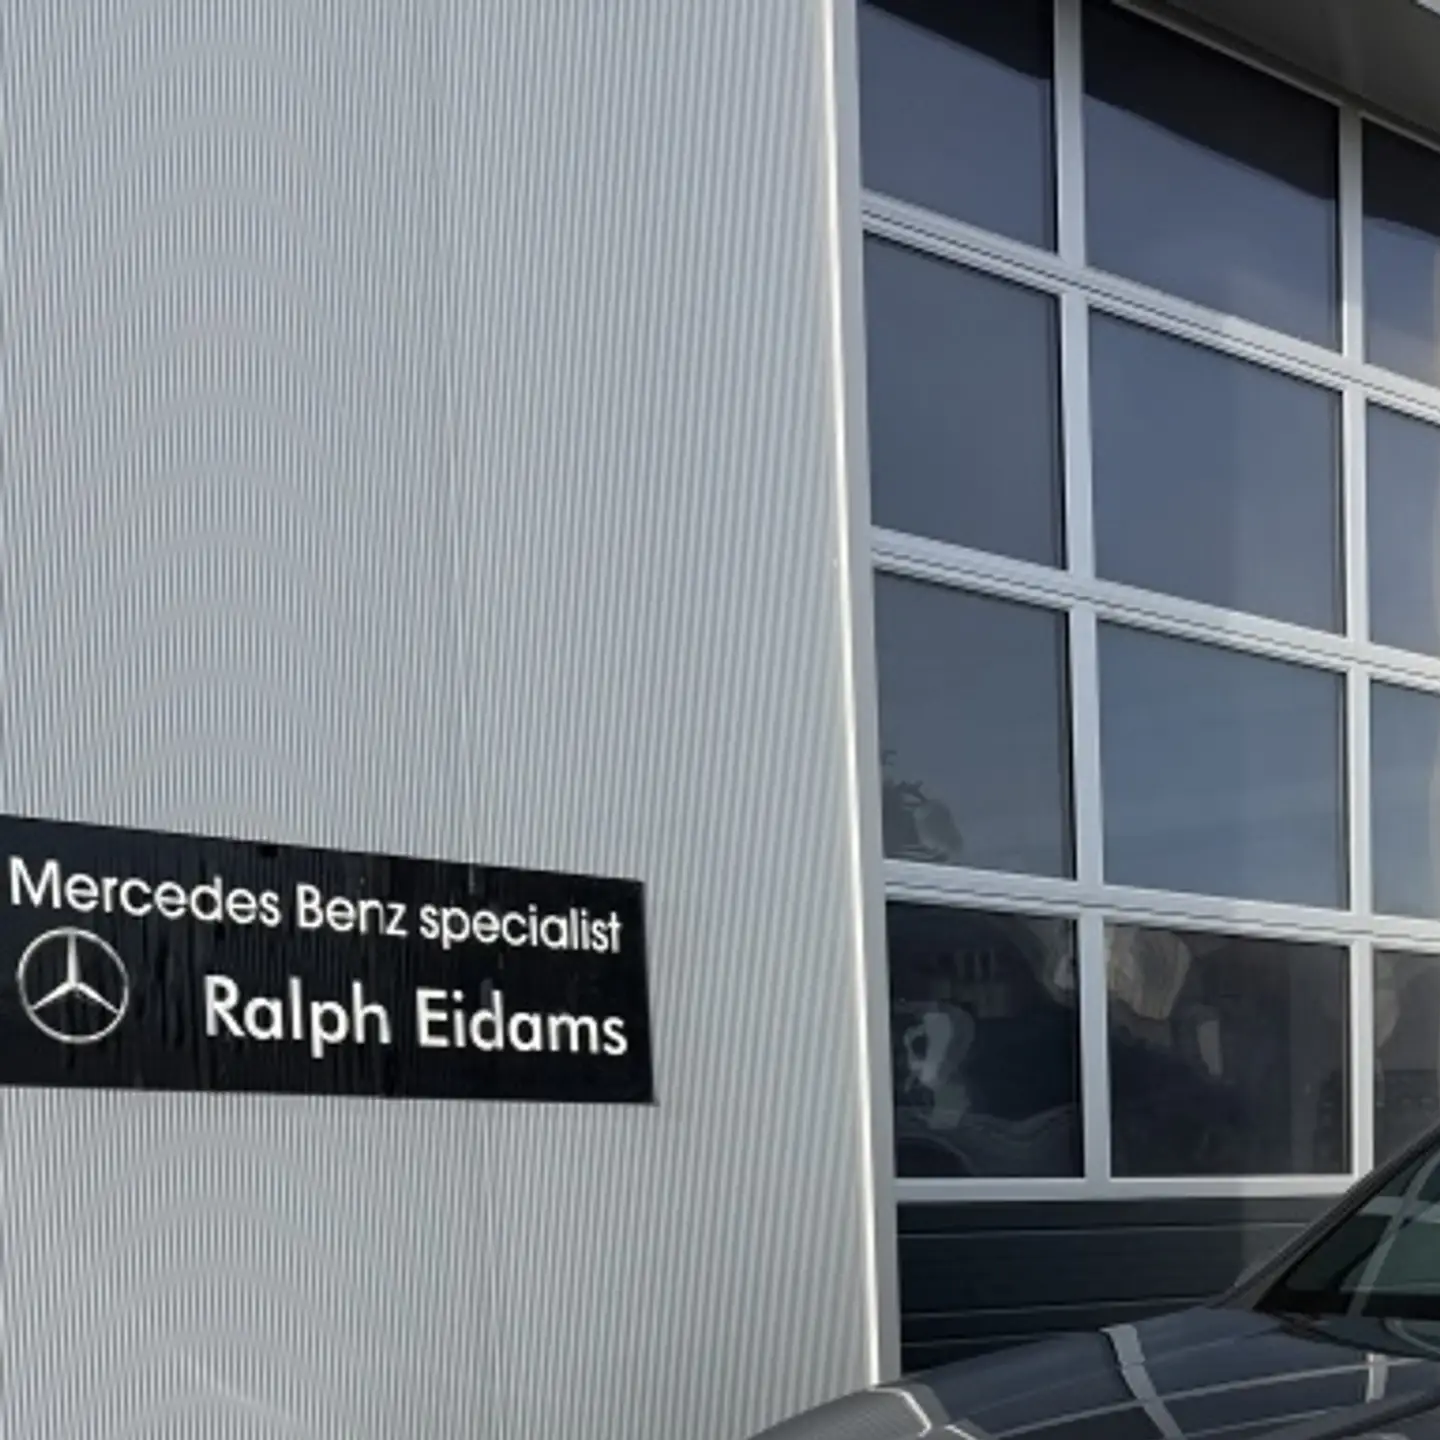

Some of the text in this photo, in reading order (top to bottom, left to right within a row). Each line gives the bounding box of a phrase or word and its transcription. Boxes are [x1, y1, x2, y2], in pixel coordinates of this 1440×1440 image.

[9, 855, 622, 954] Mercedes Benz specialist
[204, 974, 629, 1060] Ralph Eidams
